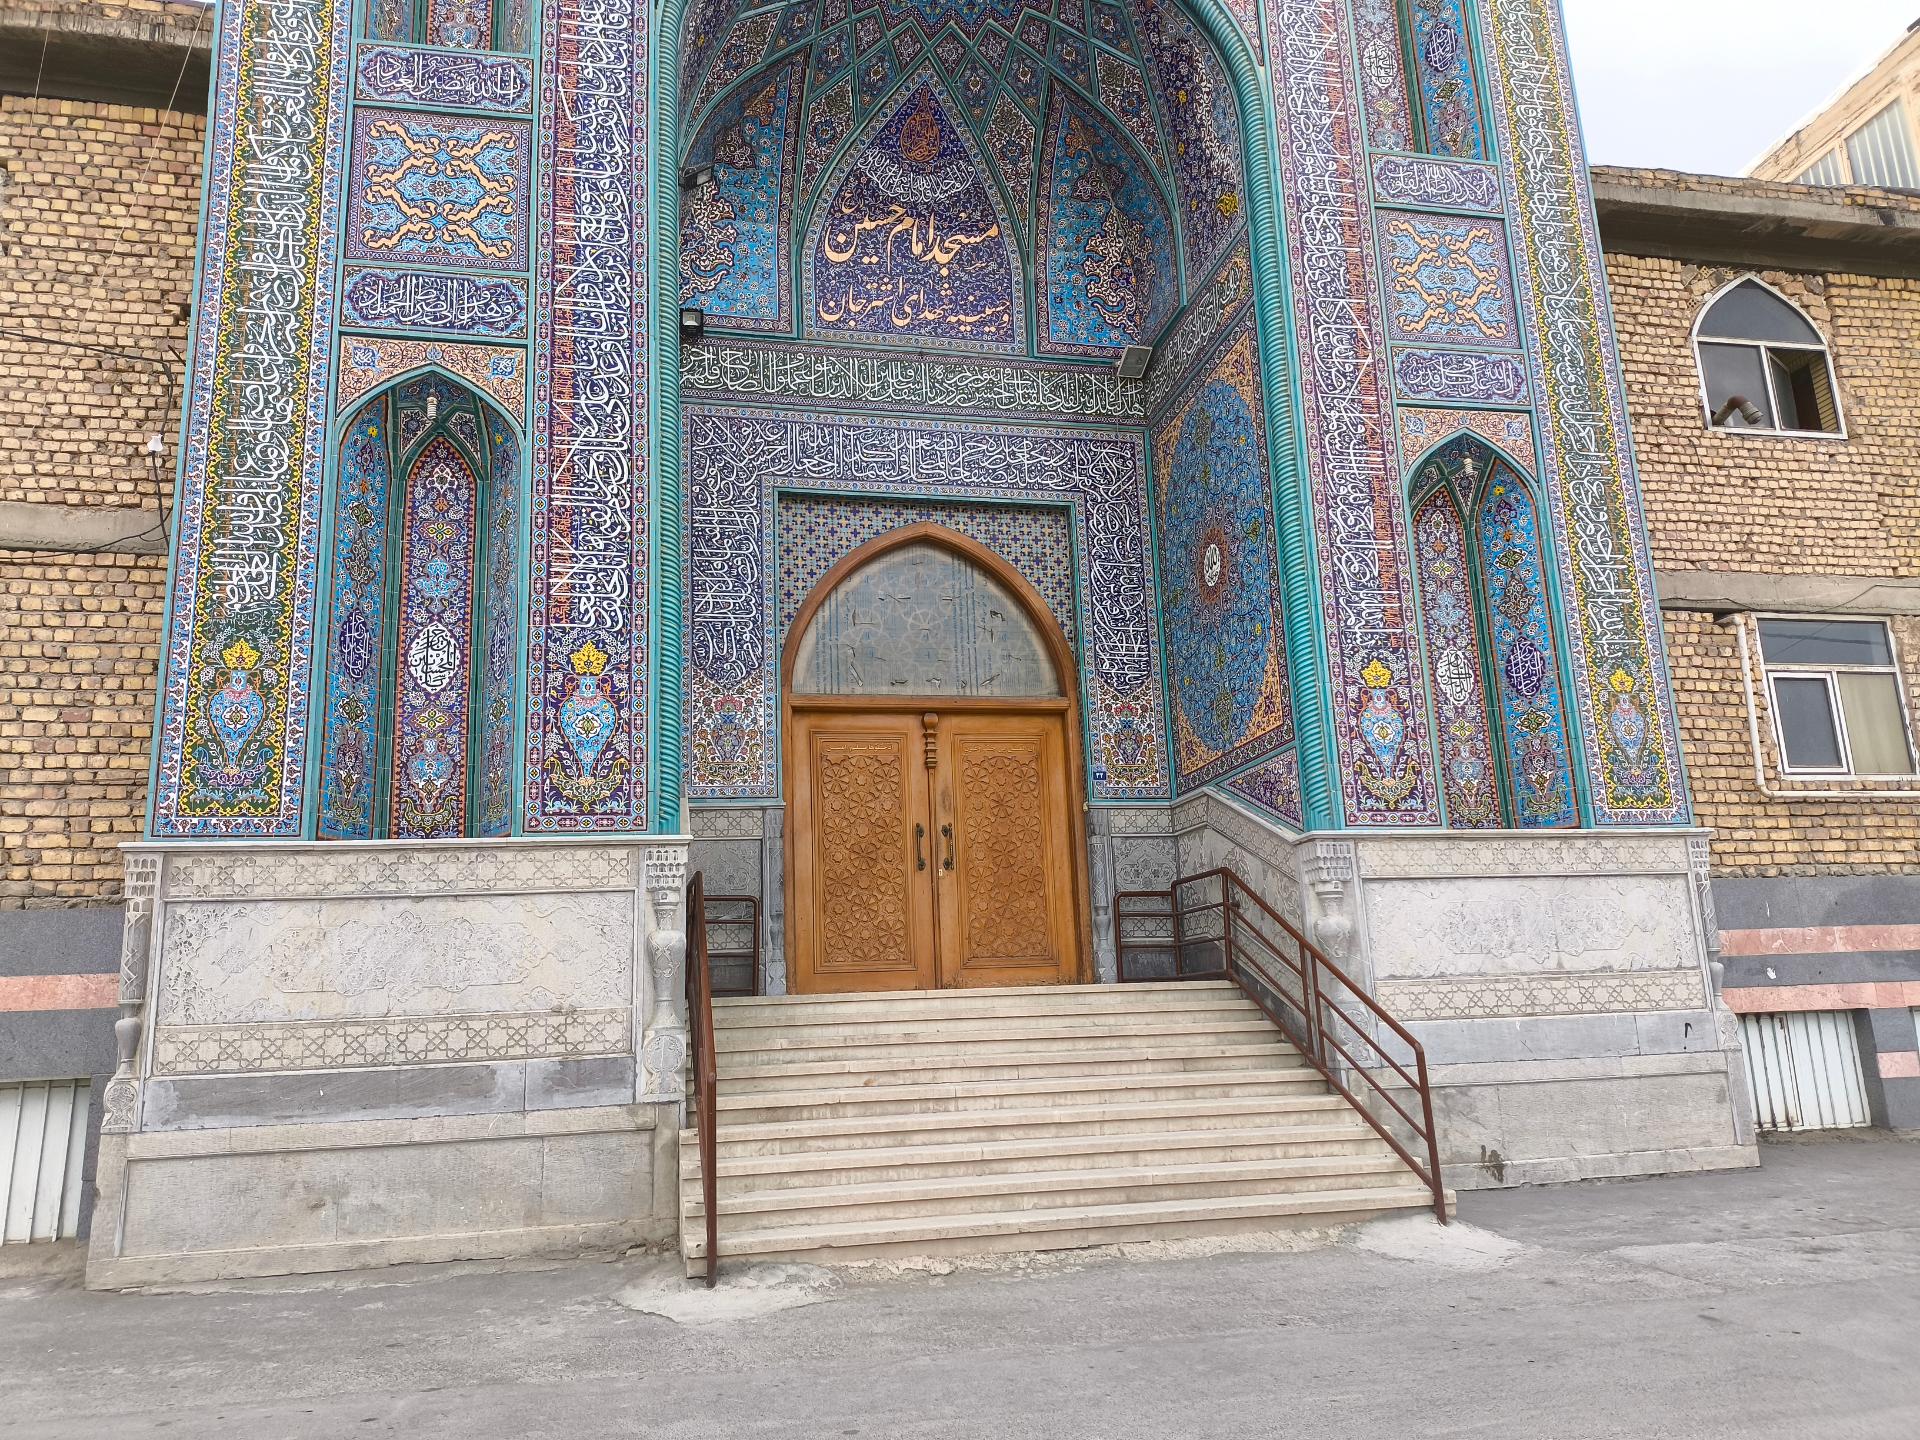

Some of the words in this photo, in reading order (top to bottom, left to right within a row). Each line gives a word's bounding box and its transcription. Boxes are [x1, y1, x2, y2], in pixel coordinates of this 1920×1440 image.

[824, 203, 907, 264] حسین
[888, 212, 935, 273] امام
[920, 212, 999, 277] مسجد
